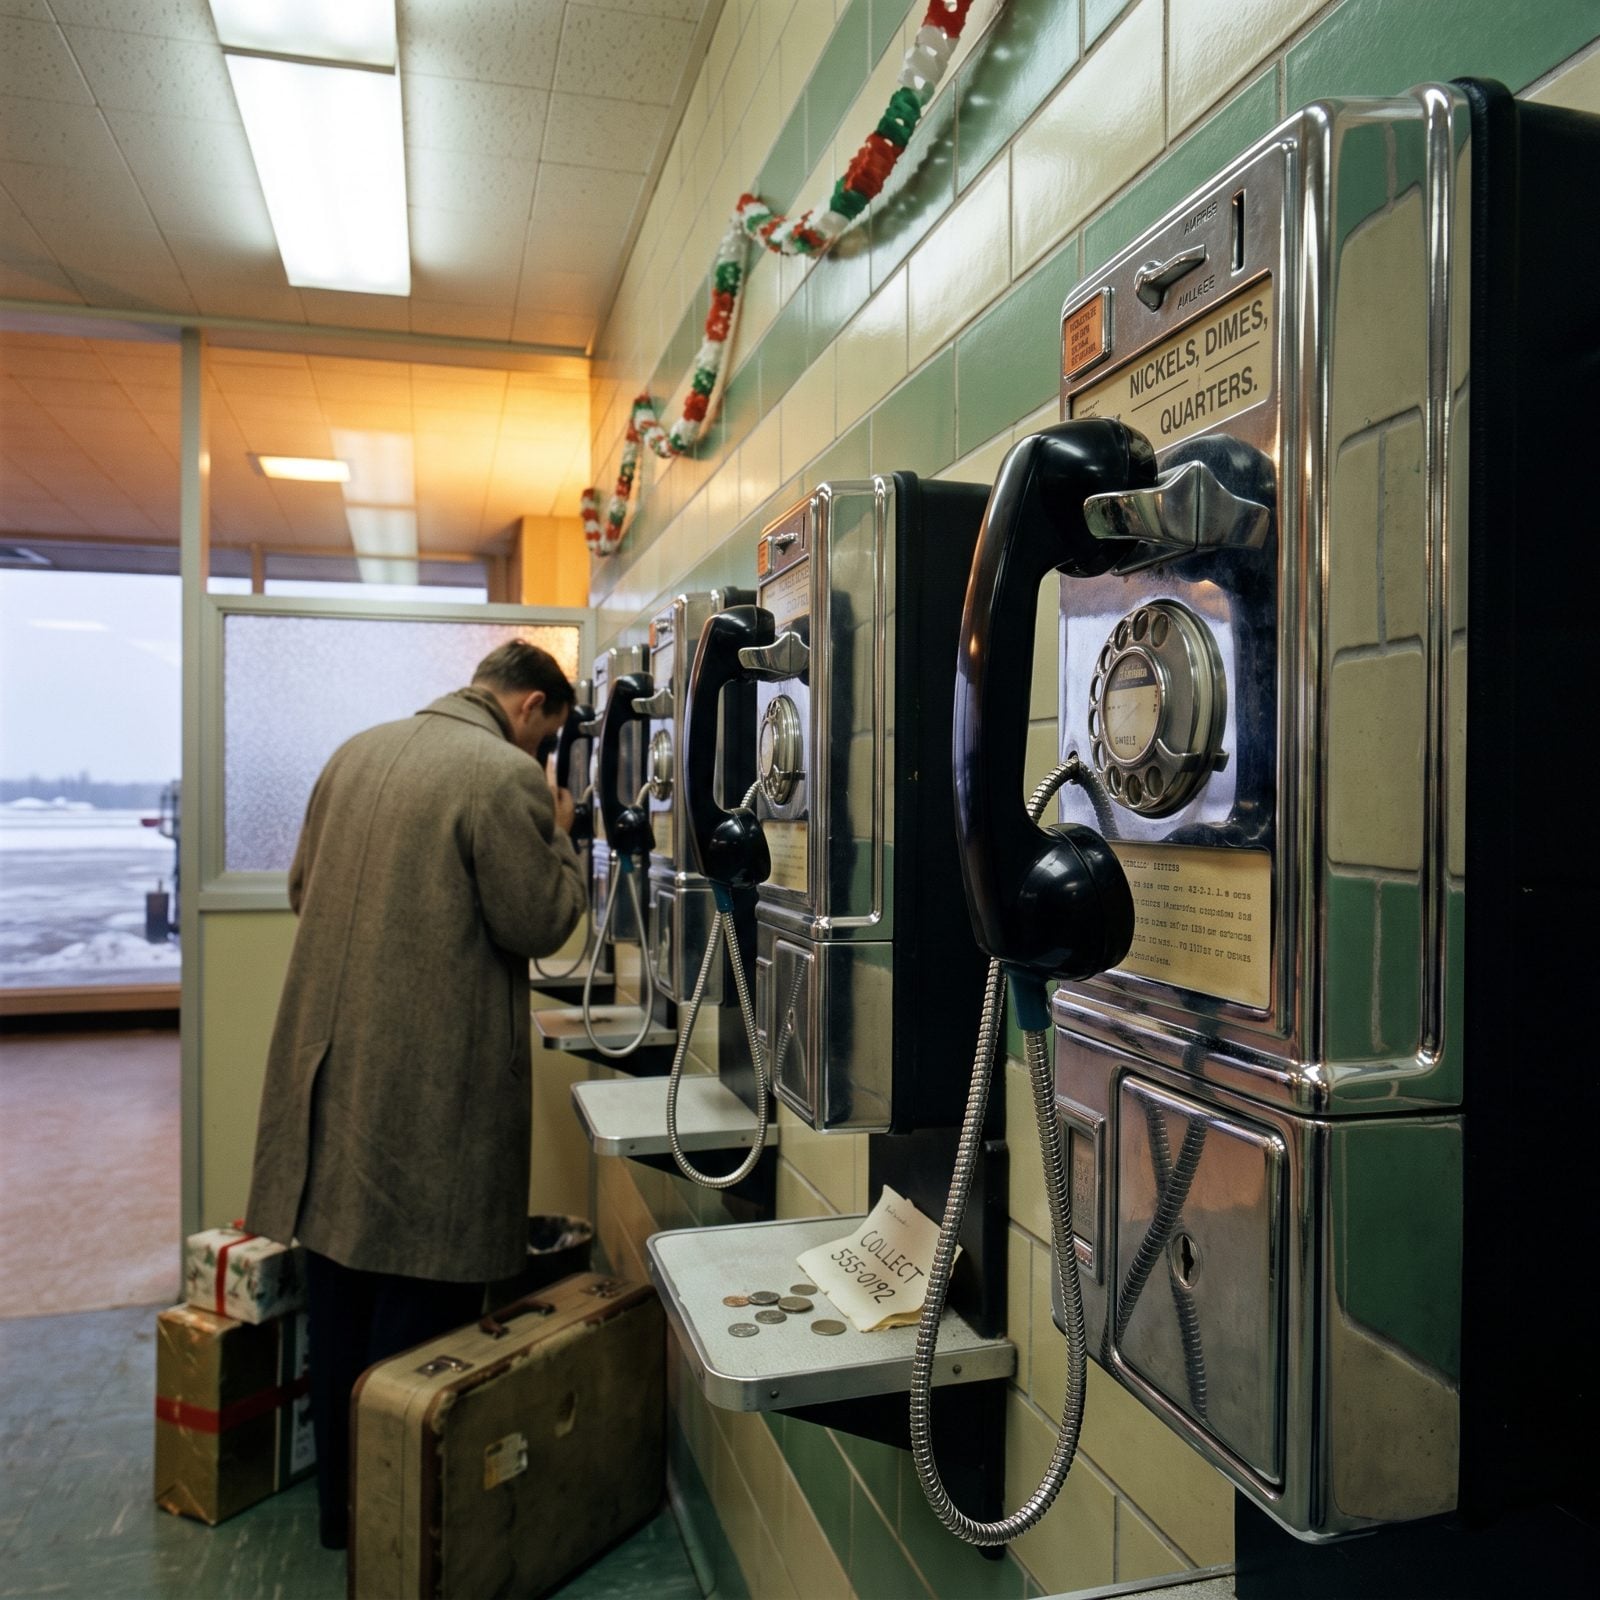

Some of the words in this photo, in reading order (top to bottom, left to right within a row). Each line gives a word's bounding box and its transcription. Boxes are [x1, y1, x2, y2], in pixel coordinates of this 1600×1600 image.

[1130, 338, 1200, 399] NICKELS,
[1205, 299, 1269, 356] DIMES,
[1160, 366, 1258, 435] QUARTERS.
[831, 1248, 896, 1304] 555-0192
[860, 1230, 924, 1285] COLLECT
